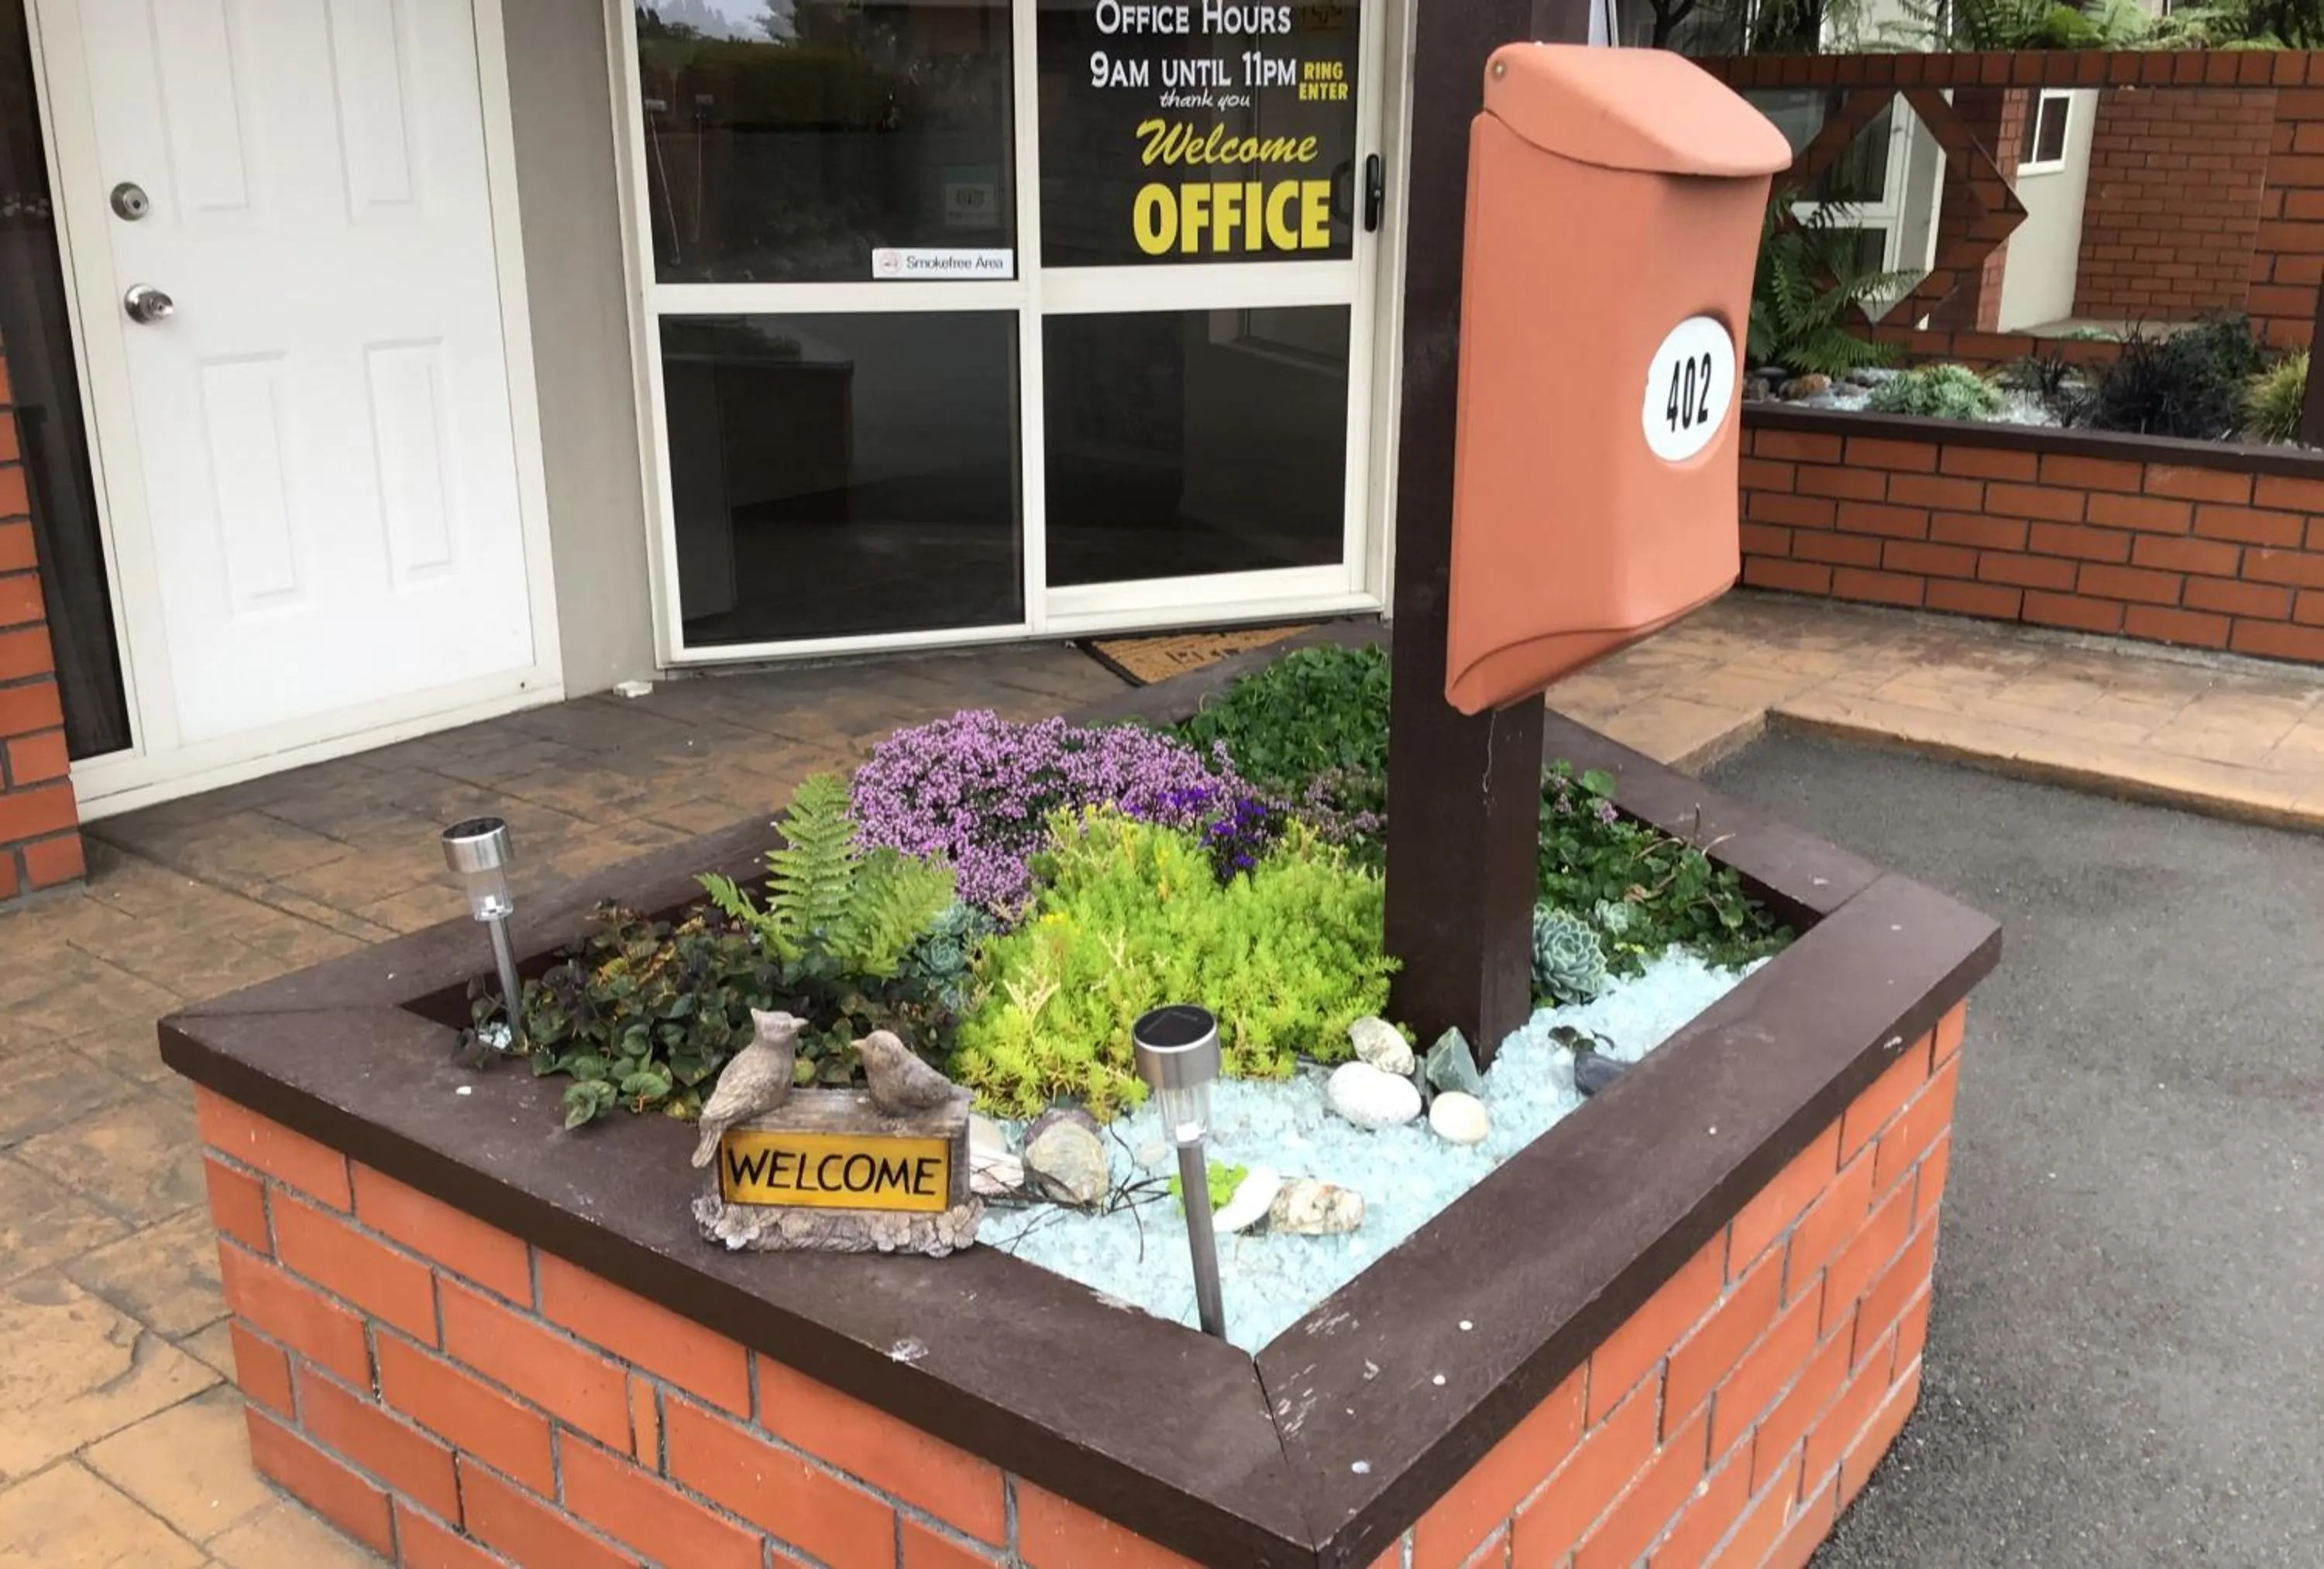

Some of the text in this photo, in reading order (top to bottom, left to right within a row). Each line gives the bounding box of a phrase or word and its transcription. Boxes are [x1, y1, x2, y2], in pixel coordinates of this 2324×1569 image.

[1095, 0, 1292, 35] OFFICE HOURS
[1090, 50, 1297, 88] 9AM UNTIL 11PM
[1304, 62, 1344, 79] RING
[1160, 90, 1250, 112] thank you
[1299, 83, 1349, 101] ENTER
[1136, 118, 1318, 167] Welcome
[1133, 180, 1331, 255] OFFICE
[906, 256, 1003, 269] Smokefree Area
[1667, 352, 1711, 434] 402
[727, 1148, 942, 1196] WELCOME
